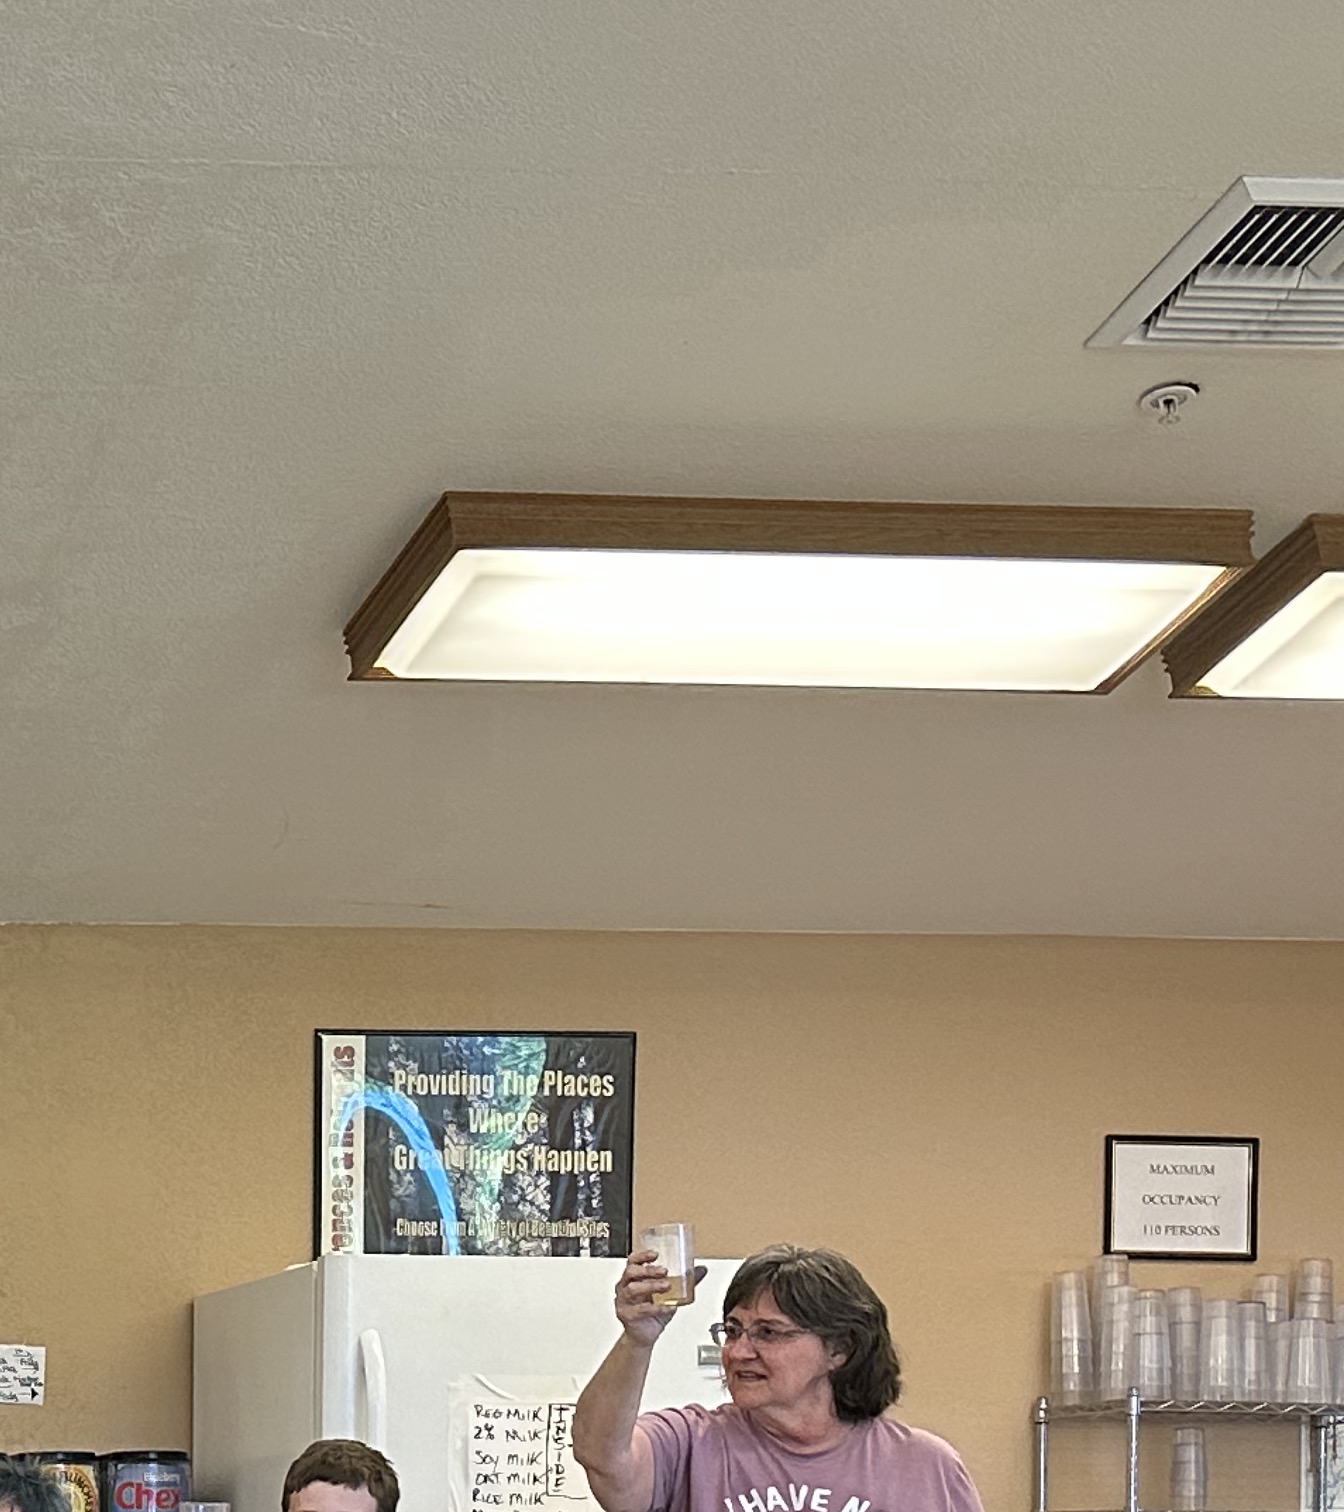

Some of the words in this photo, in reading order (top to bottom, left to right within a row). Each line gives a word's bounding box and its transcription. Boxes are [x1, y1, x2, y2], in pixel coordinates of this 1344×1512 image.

[394, 1069, 495, 1099] Providing
[502, 1070, 538, 1097] The
[543, 1070, 615, 1097] Places
[468, 1108, 539, 1134] Where
[534, 1148, 612, 1174] Happen
[1148, 1163, 1216, 1176] MAXIMUM
[1142, 1194, 1221, 1206] OCCUPANCY
[396, 1218, 438, 1237] Choose
[1143, 1224, 1161, 1236] 110
[1164, 1225, 1221, 1236] PERSONS
[474, 1423, 494, 1440] 2%
[115, 1481, 181, 1511] Chex
